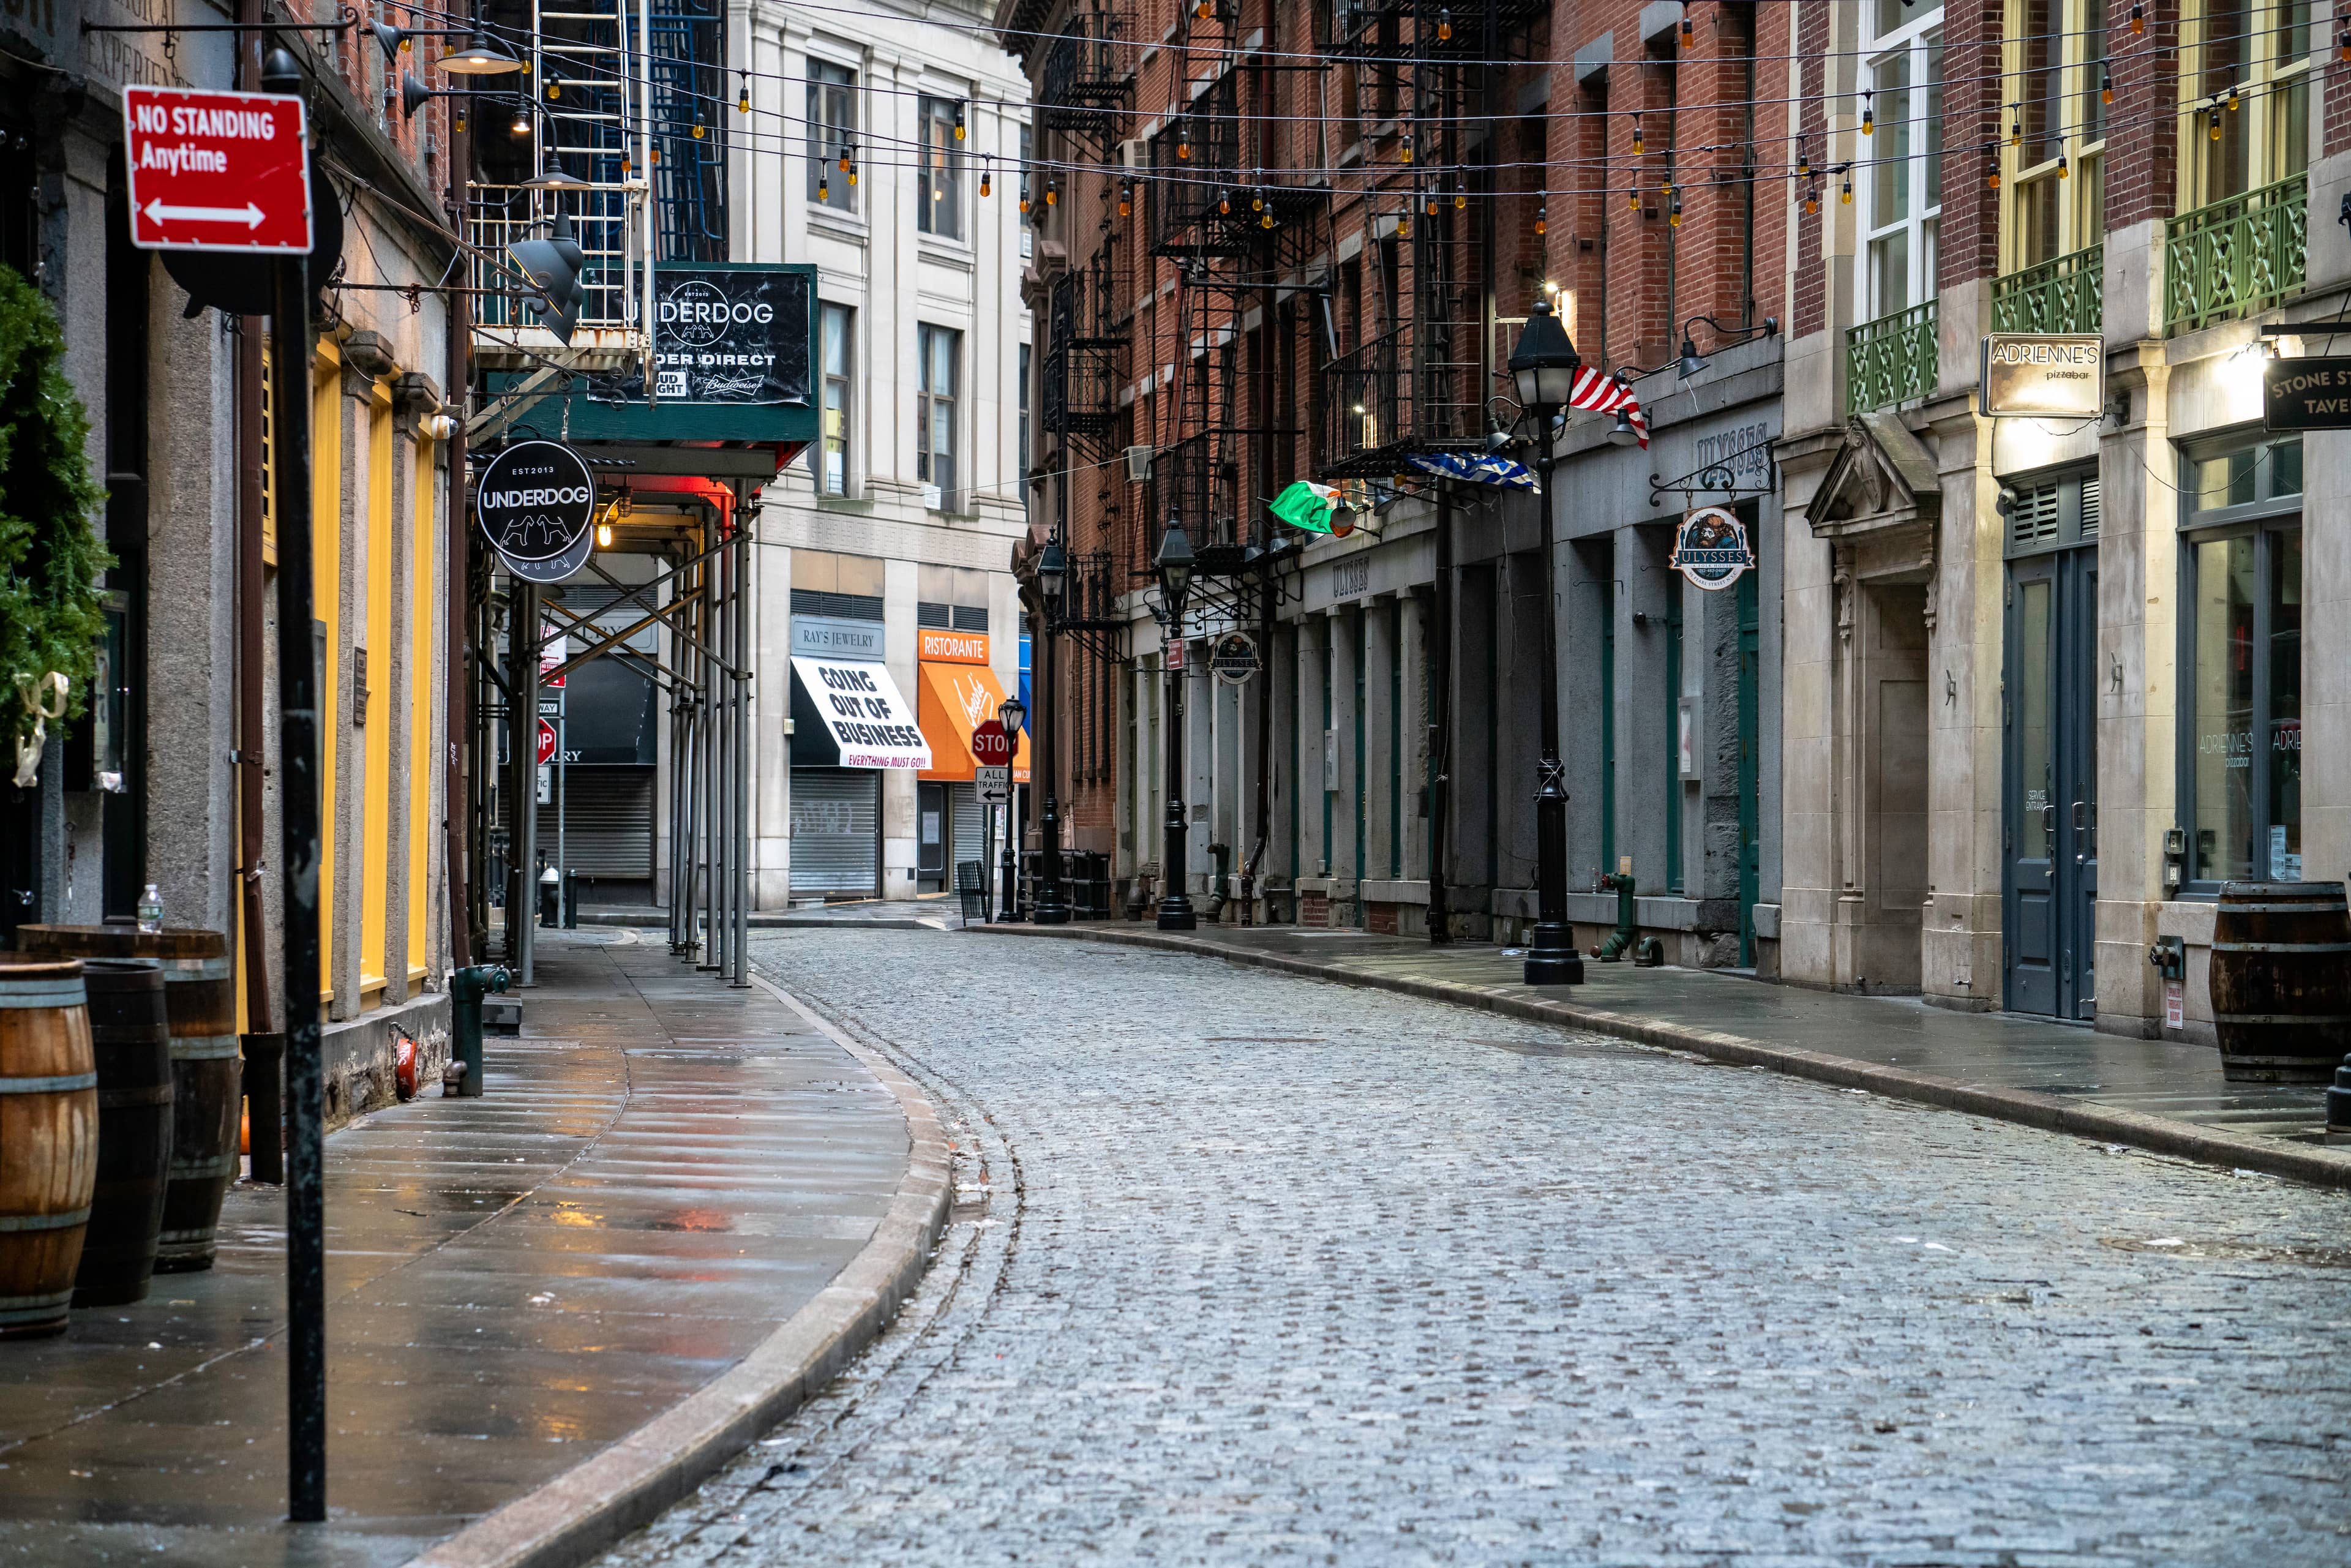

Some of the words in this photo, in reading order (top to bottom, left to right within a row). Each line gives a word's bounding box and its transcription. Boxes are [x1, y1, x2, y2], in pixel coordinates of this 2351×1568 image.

[137, 104, 167, 135] NO
[172, 107, 276, 141] STANDING
[141, 140, 228, 178] Anytime
[623, 302, 773, 324] UDERDOG
[702, 354, 776, 366] DIRECT
[1993, 345, 2098, 364] ADRIENNE'S
[657, 374, 678, 384] UD
[703, 379, 763, 389] Budweiser
[2046, 370, 2090, 381] pizzabar
[657, 384, 683, 394] GHT
[2272, 371, 2331, 399] STONE
[2304, 398, 2351, 414] TAVE
[484, 486, 589, 508] UNDERDOG
[804, 630, 828, 643] RAY'S
[831, 632, 874, 647] JEWELRY
[925, 636, 983, 658] RISTORANTE
[818, 667, 877, 692] GOING
[829, 693, 866, 718] OUT
[864, 697, 891, 719] OF
[831, 721, 923, 747] BUSINESS
[849, 754, 889, 767] EVERYTHING
[890, 757, 910, 767] MUST
[910, 757, 926, 768] GO!!
[2226, 755, 2249, 768] pizzabar
[984, 770, 1004, 779] ALL
[2028, 790, 2045, 800] SERVICE
